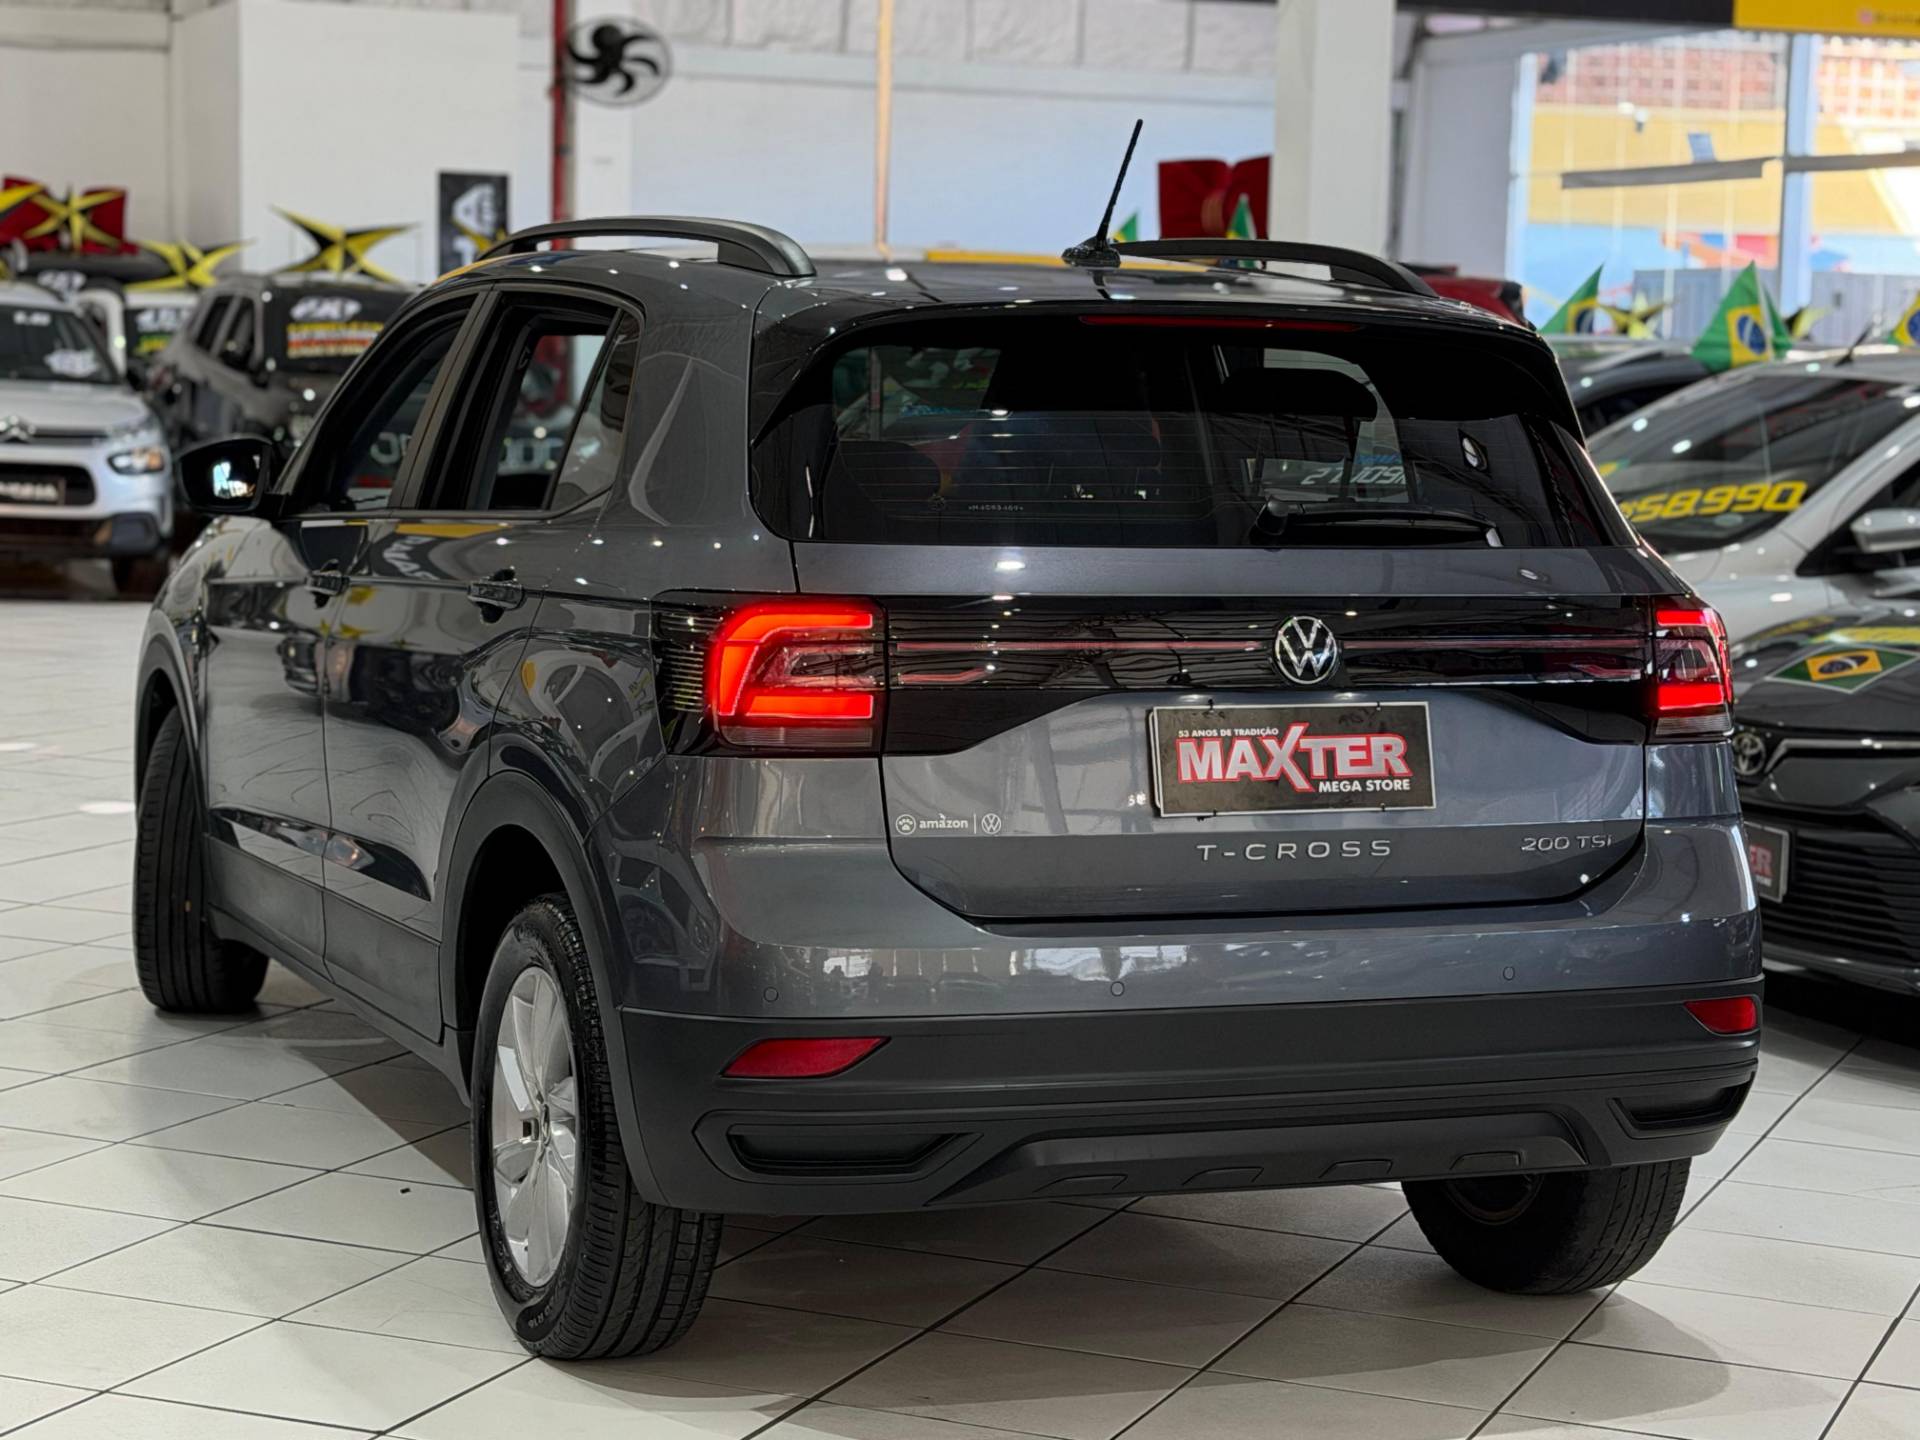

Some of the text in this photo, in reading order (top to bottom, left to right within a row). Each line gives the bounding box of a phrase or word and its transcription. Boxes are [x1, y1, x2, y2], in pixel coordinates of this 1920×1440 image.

[1191, 728, 1218, 737] ANOS
[1220, 728, 1232, 737] DE
[1176, 722, 1413, 792] MAXTER
[1318, 779, 1411, 792] MEGA STORE
[1196, 840, 1392, 861] T-CROSS
[1521, 836, 1570, 851] 200
